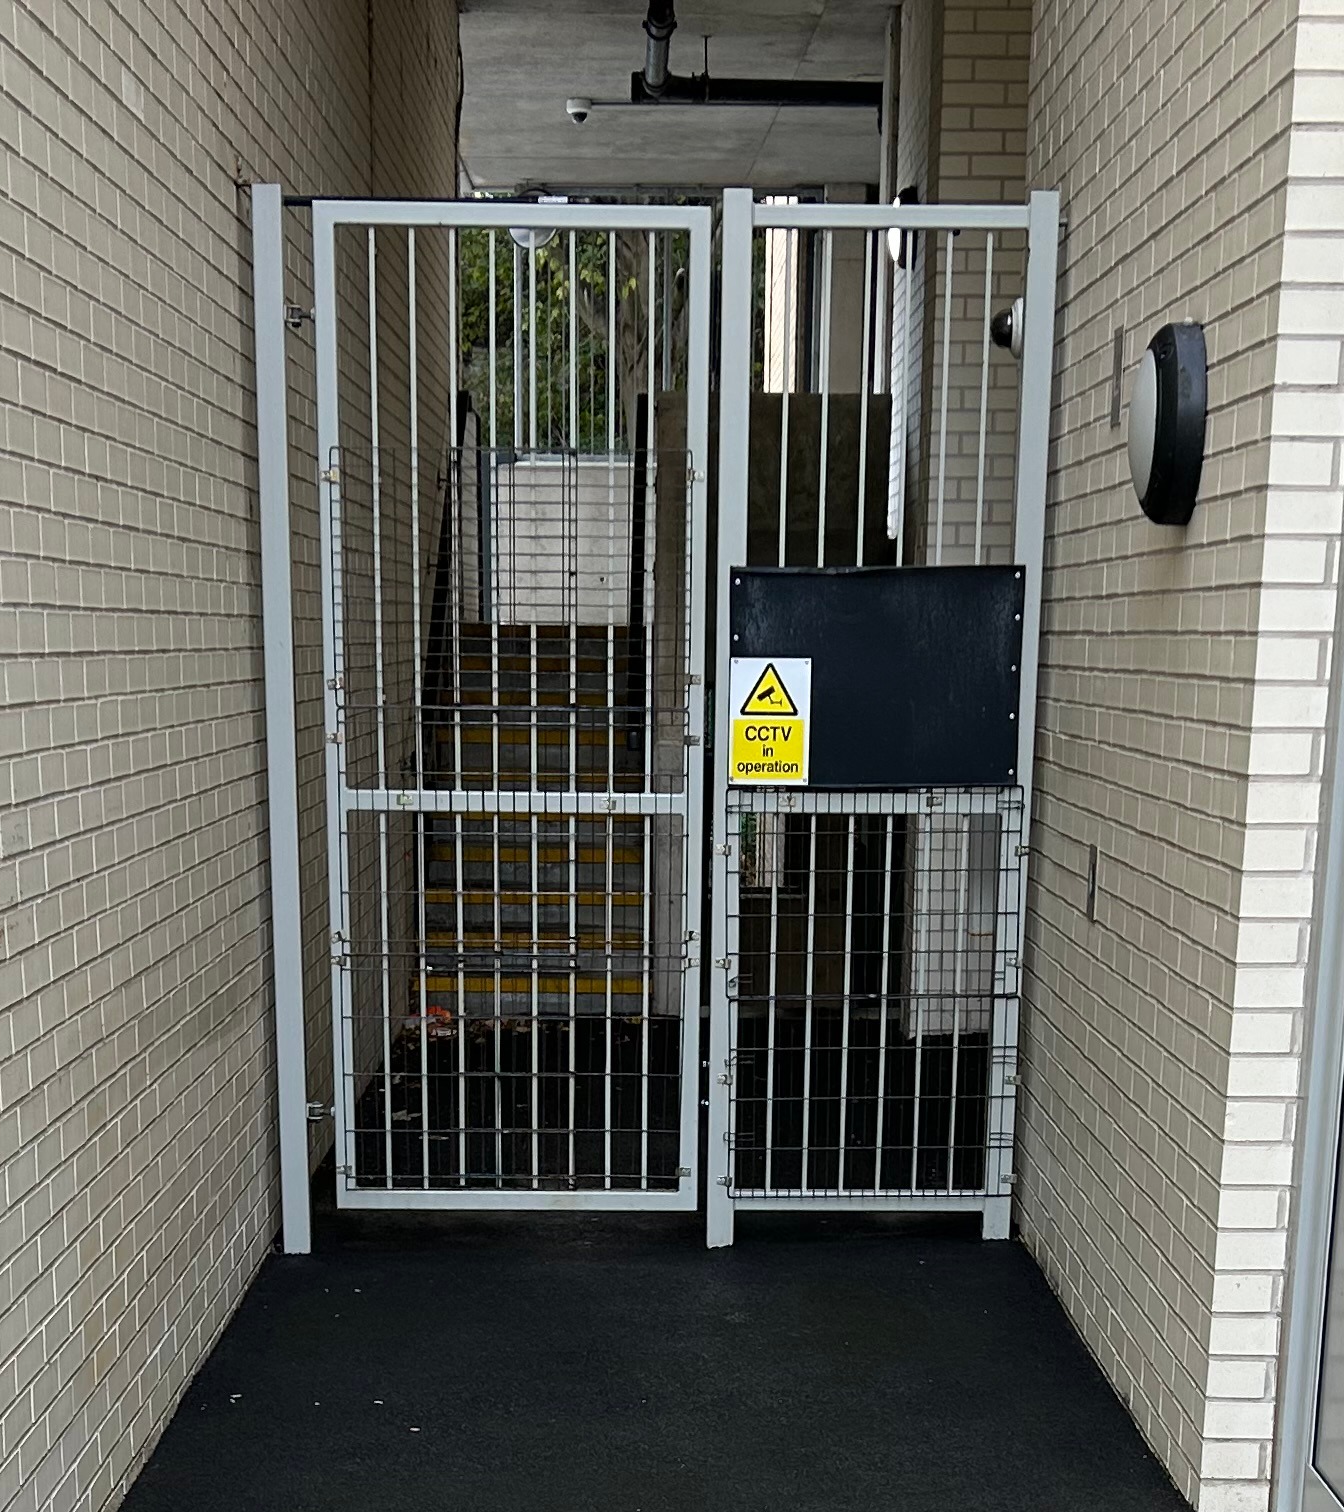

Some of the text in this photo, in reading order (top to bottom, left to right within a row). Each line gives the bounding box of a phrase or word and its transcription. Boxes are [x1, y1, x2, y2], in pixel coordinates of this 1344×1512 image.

[744, 725, 793, 742] CCTV
[762, 744, 774, 758] in
[737, 760, 799, 775] operation
